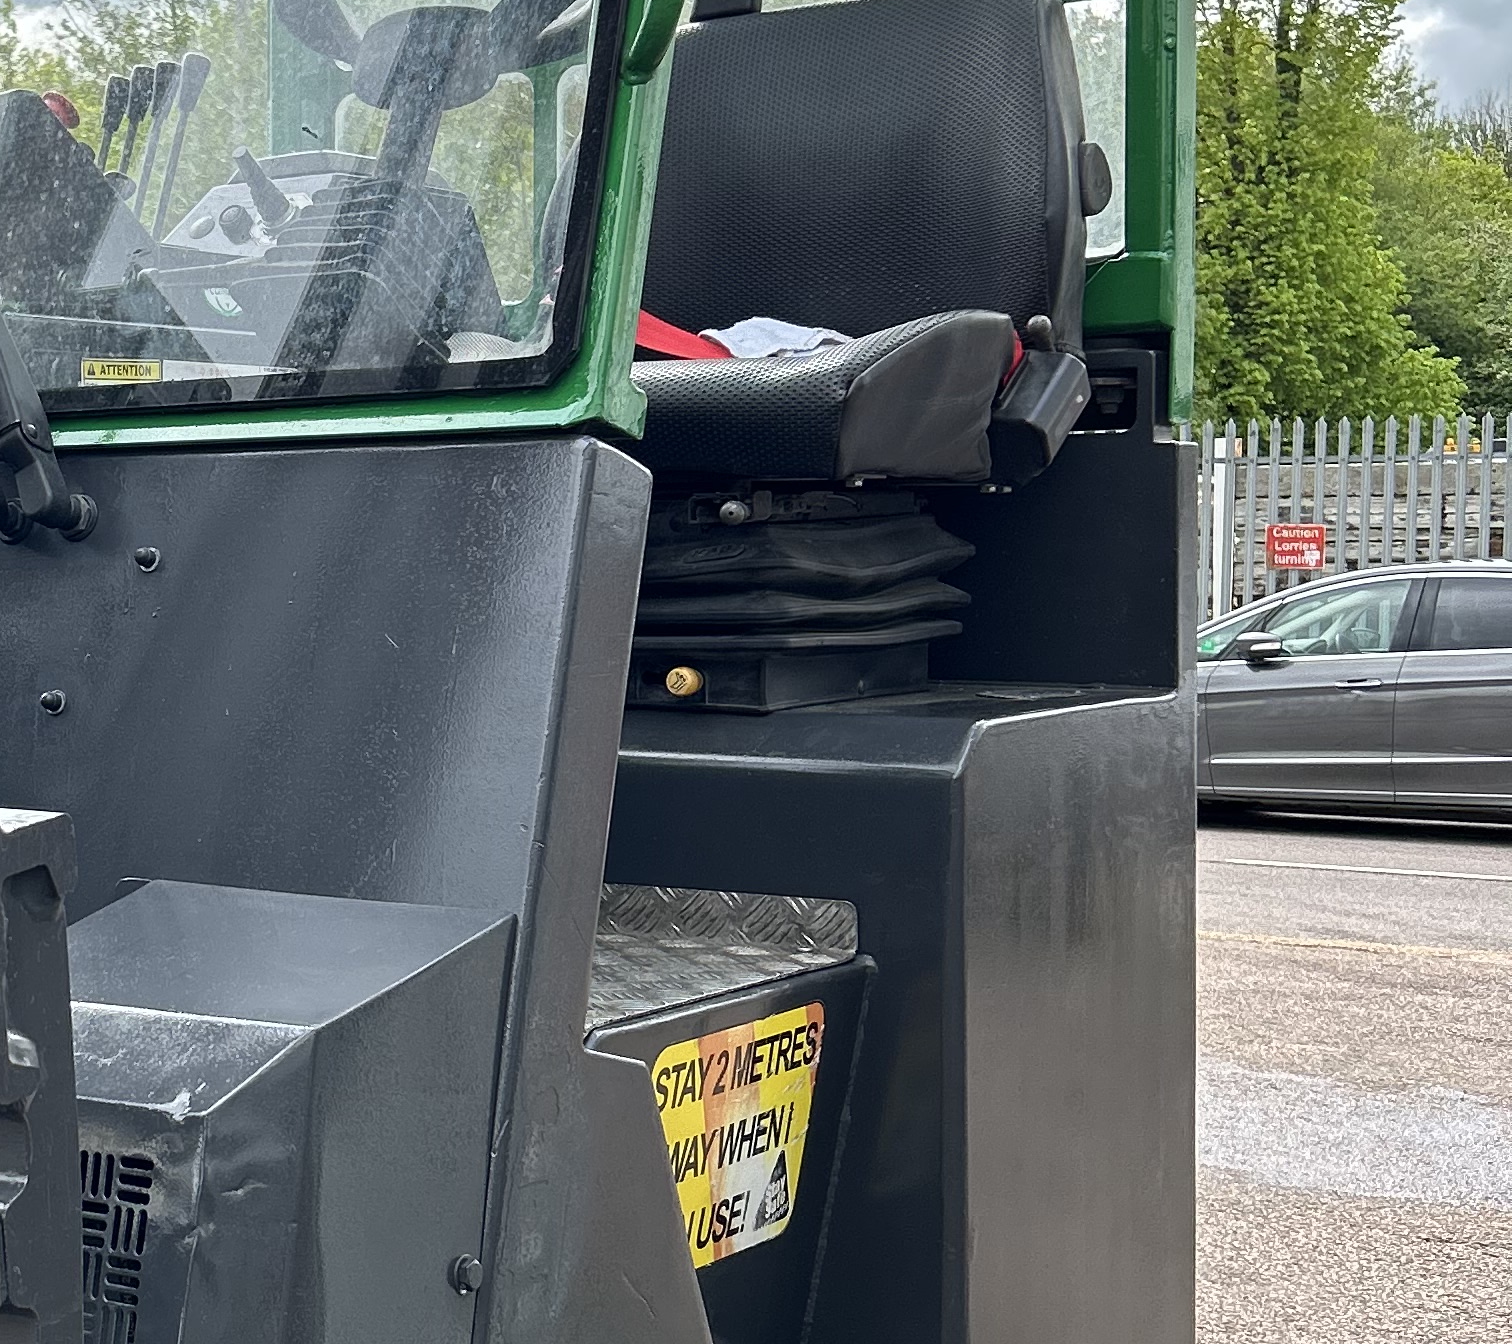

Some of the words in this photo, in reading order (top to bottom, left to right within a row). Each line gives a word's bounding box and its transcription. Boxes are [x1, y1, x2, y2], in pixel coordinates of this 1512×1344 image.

[99, 364, 152, 377] ATTENTION
[1272, 526, 1320, 538] Caution
[1274, 541, 1318, 552] Lorries
[655, 1052, 715, 1113] STAY
[712, 1049, 731, 1096] 2
[729, 1021, 821, 1090] METRES
[667, 1128, 719, 1184] WAY
[717, 1104, 787, 1169] WHEN
[695, 1190, 752, 1250] USE!
